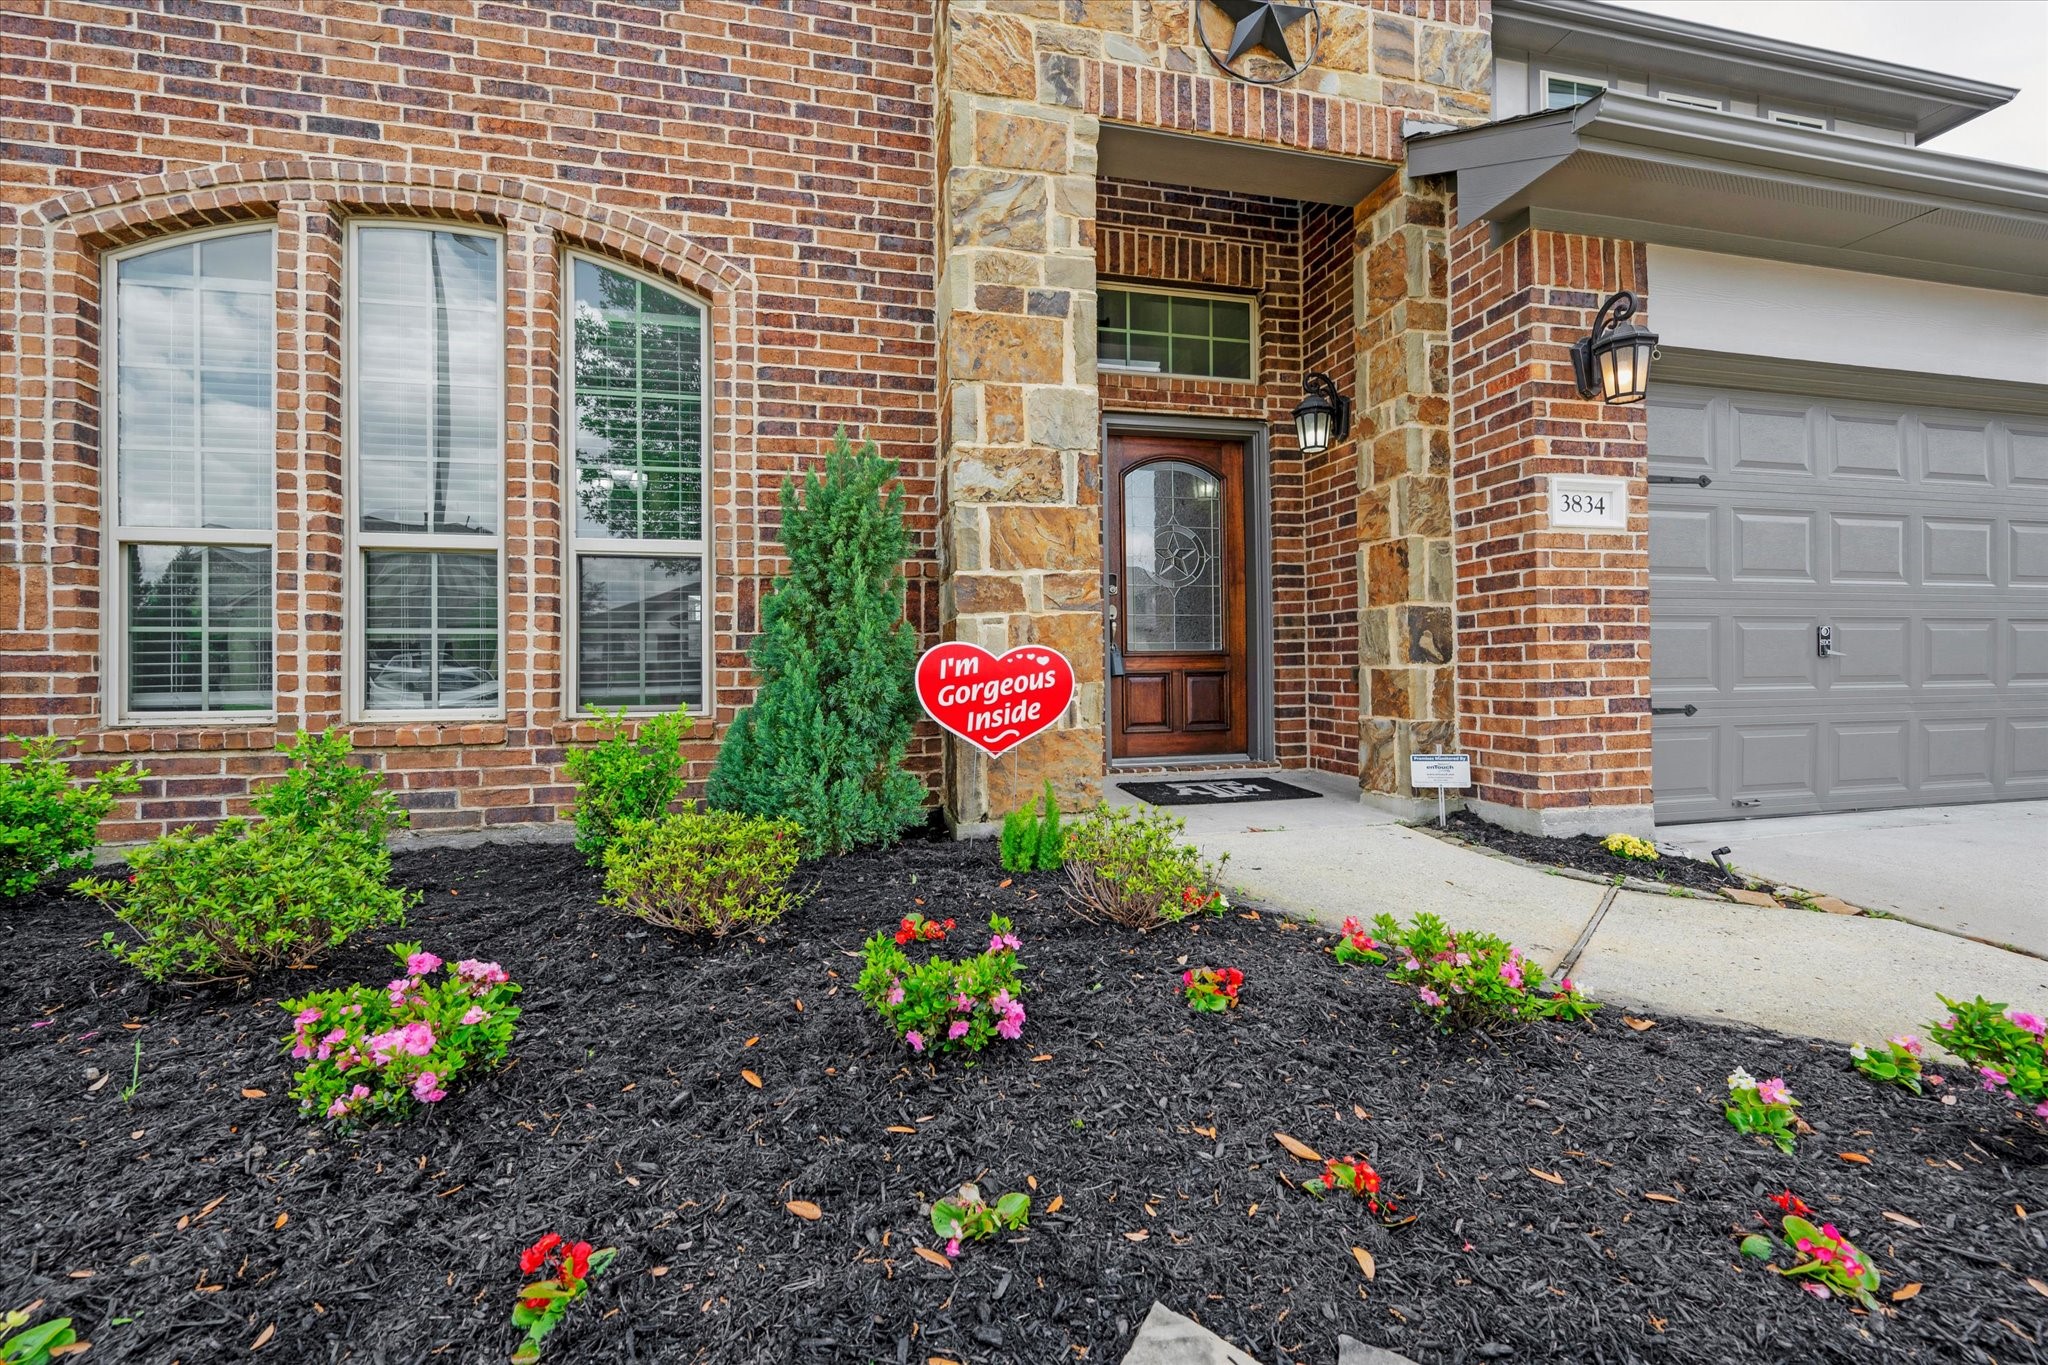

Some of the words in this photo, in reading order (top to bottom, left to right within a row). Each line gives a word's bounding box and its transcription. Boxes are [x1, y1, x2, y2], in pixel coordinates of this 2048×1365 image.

[1560, 494, 1605, 515] 3834
[939, 656, 979, 680] I'm
[937, 669, 1056, 707] Gorgeous
[967, 699, 1041, 732] Inside
